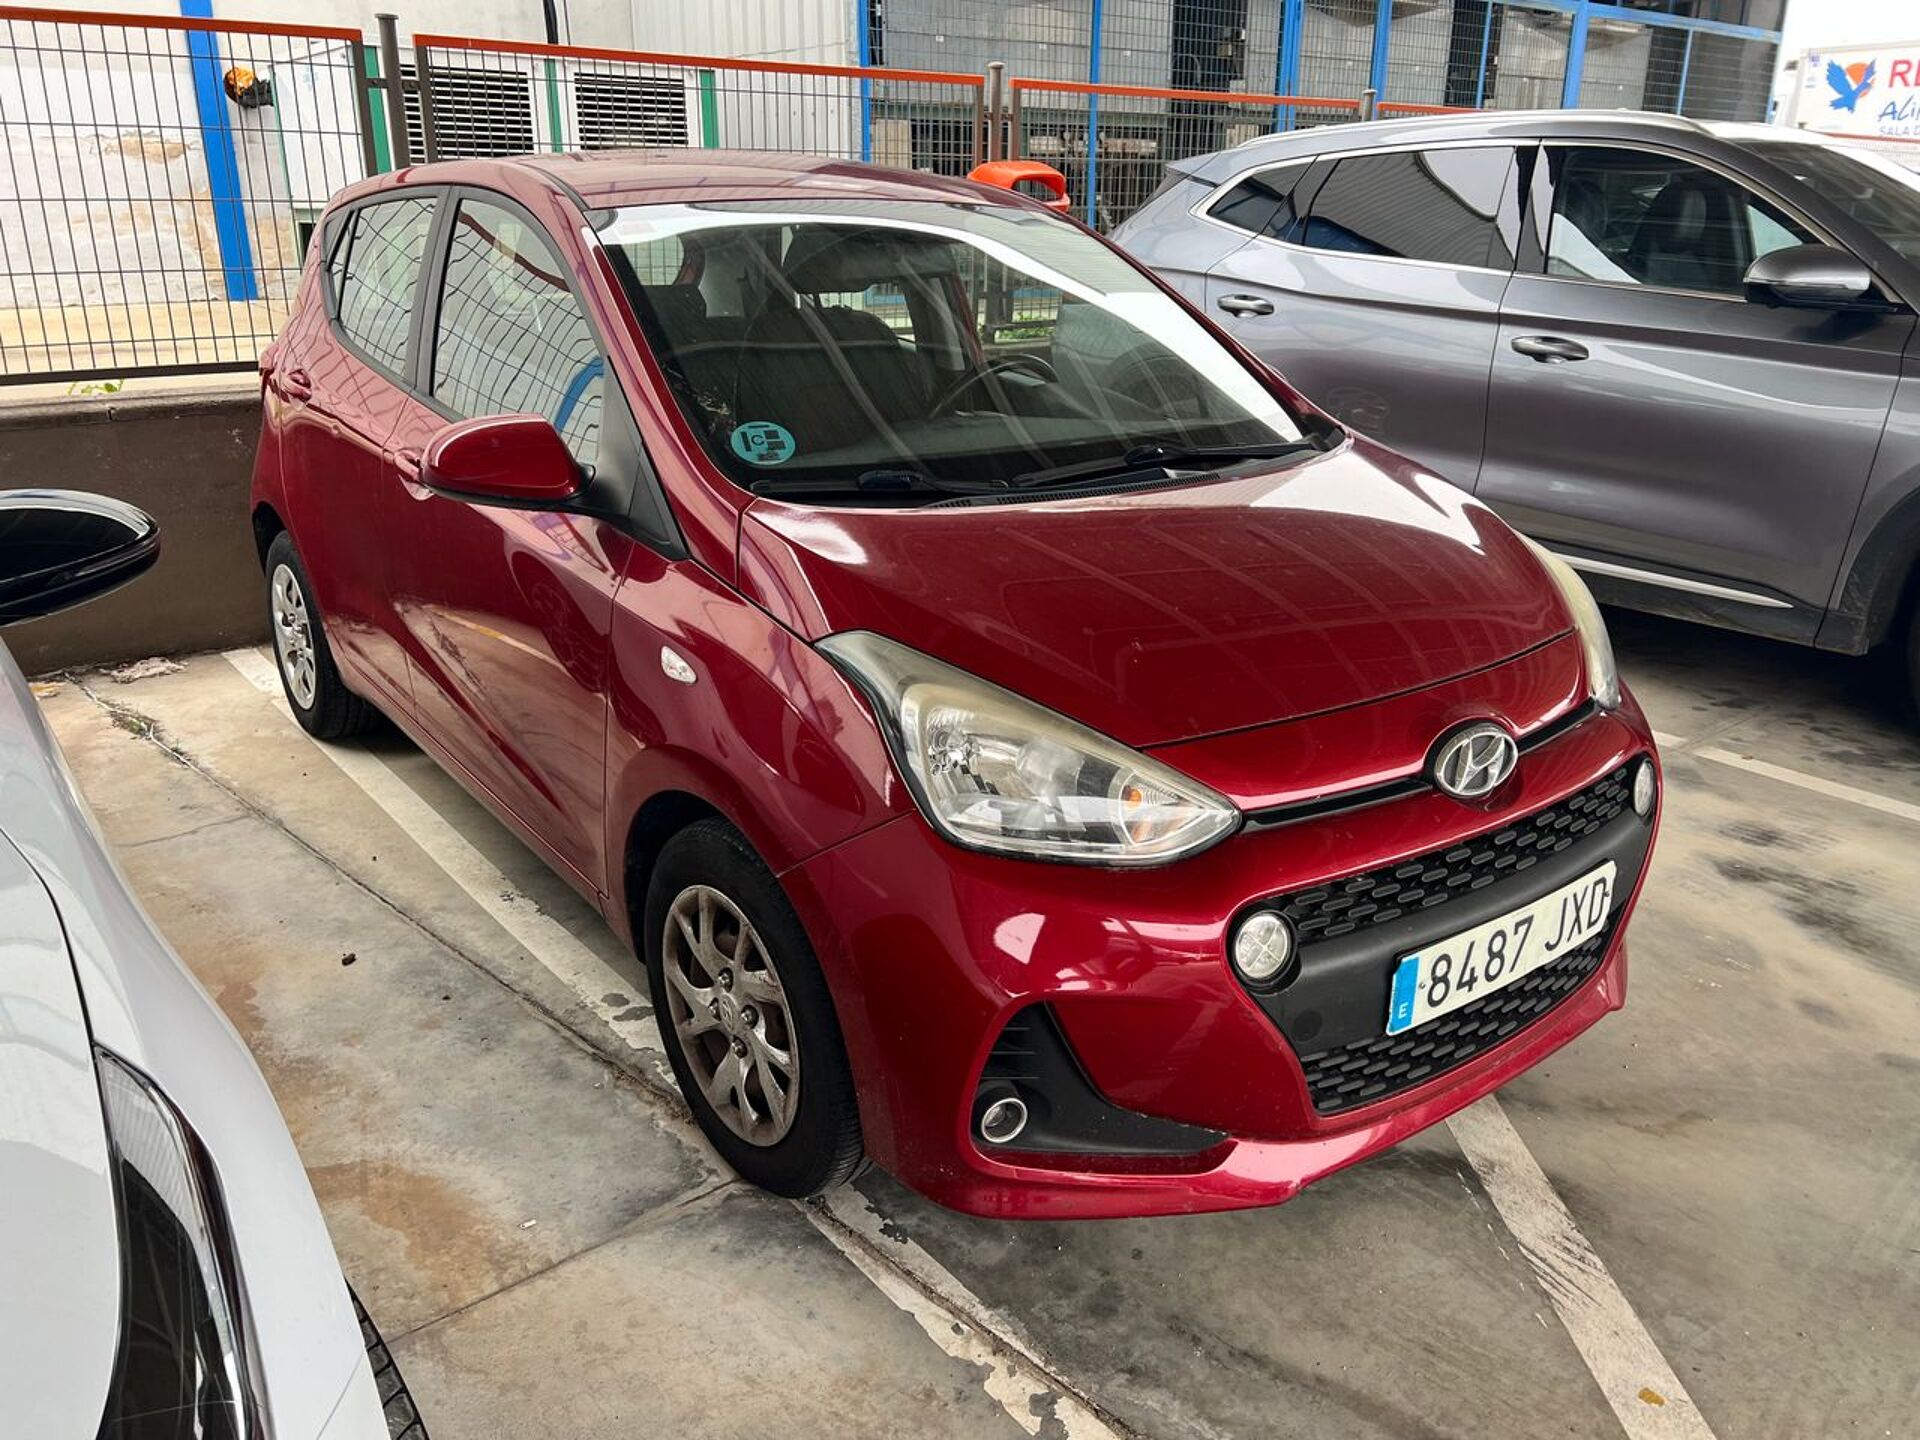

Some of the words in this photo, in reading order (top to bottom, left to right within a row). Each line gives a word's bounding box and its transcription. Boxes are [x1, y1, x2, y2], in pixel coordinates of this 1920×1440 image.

[751, 434, 765, 446] C
[1427, 915, 1534, 1008] 8487
[1544, 876, 1608, 952] JXD
[1398, 1002, 1409, 1019] E
